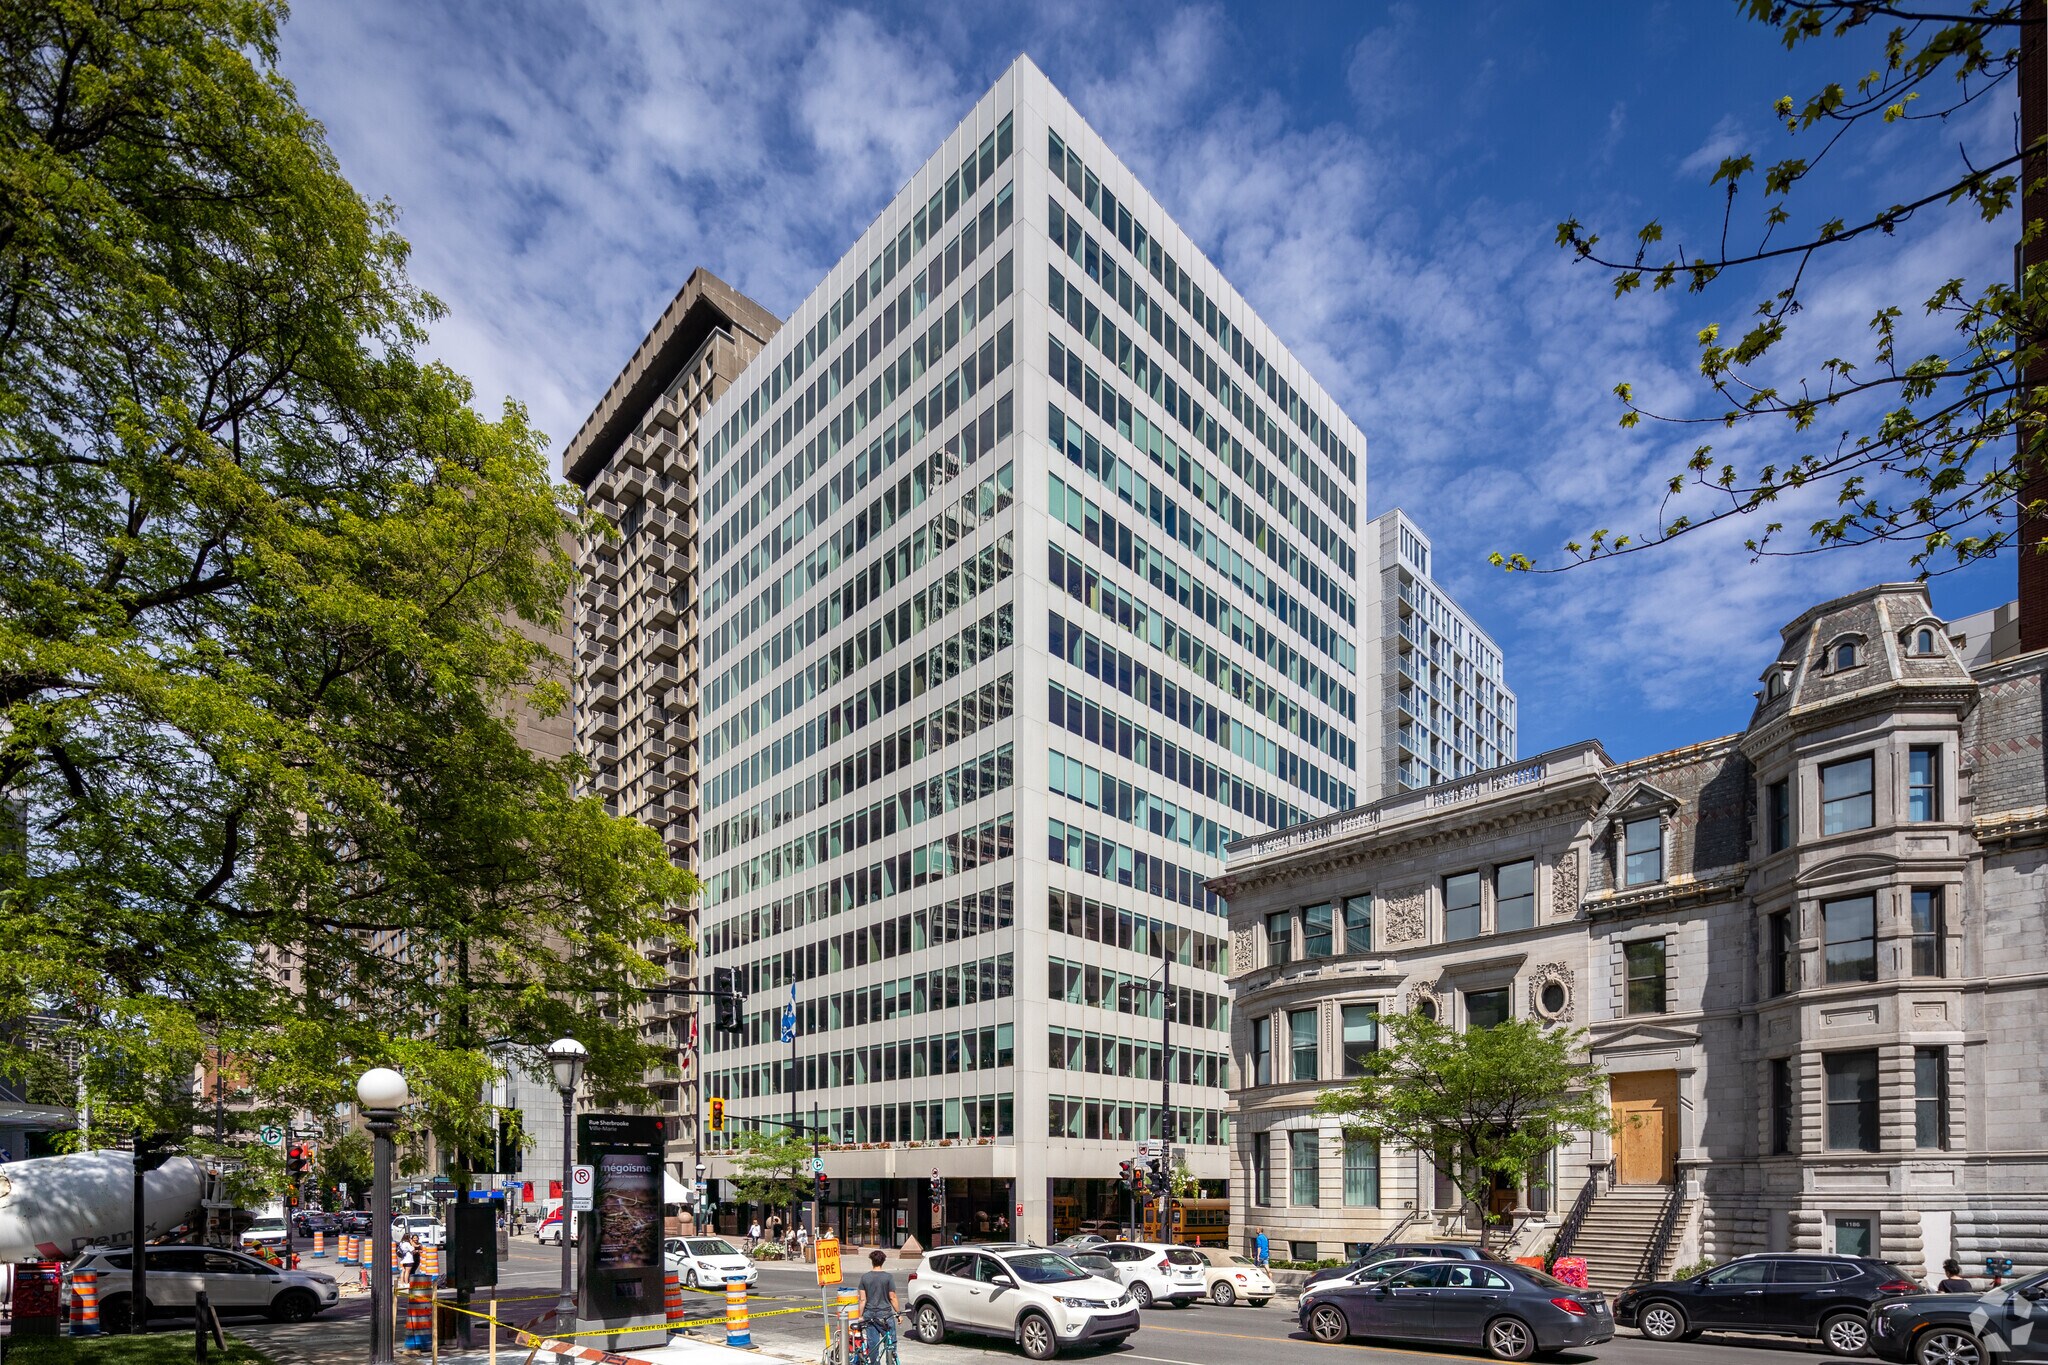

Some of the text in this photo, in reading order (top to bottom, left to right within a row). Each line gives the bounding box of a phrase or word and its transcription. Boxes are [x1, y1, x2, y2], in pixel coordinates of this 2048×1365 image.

[600, 1119, 630, 1127] Sherbrooke
[600, 1163, 652, 1174] mégoïsme
[71, 1221, 157, 1250] Demx
